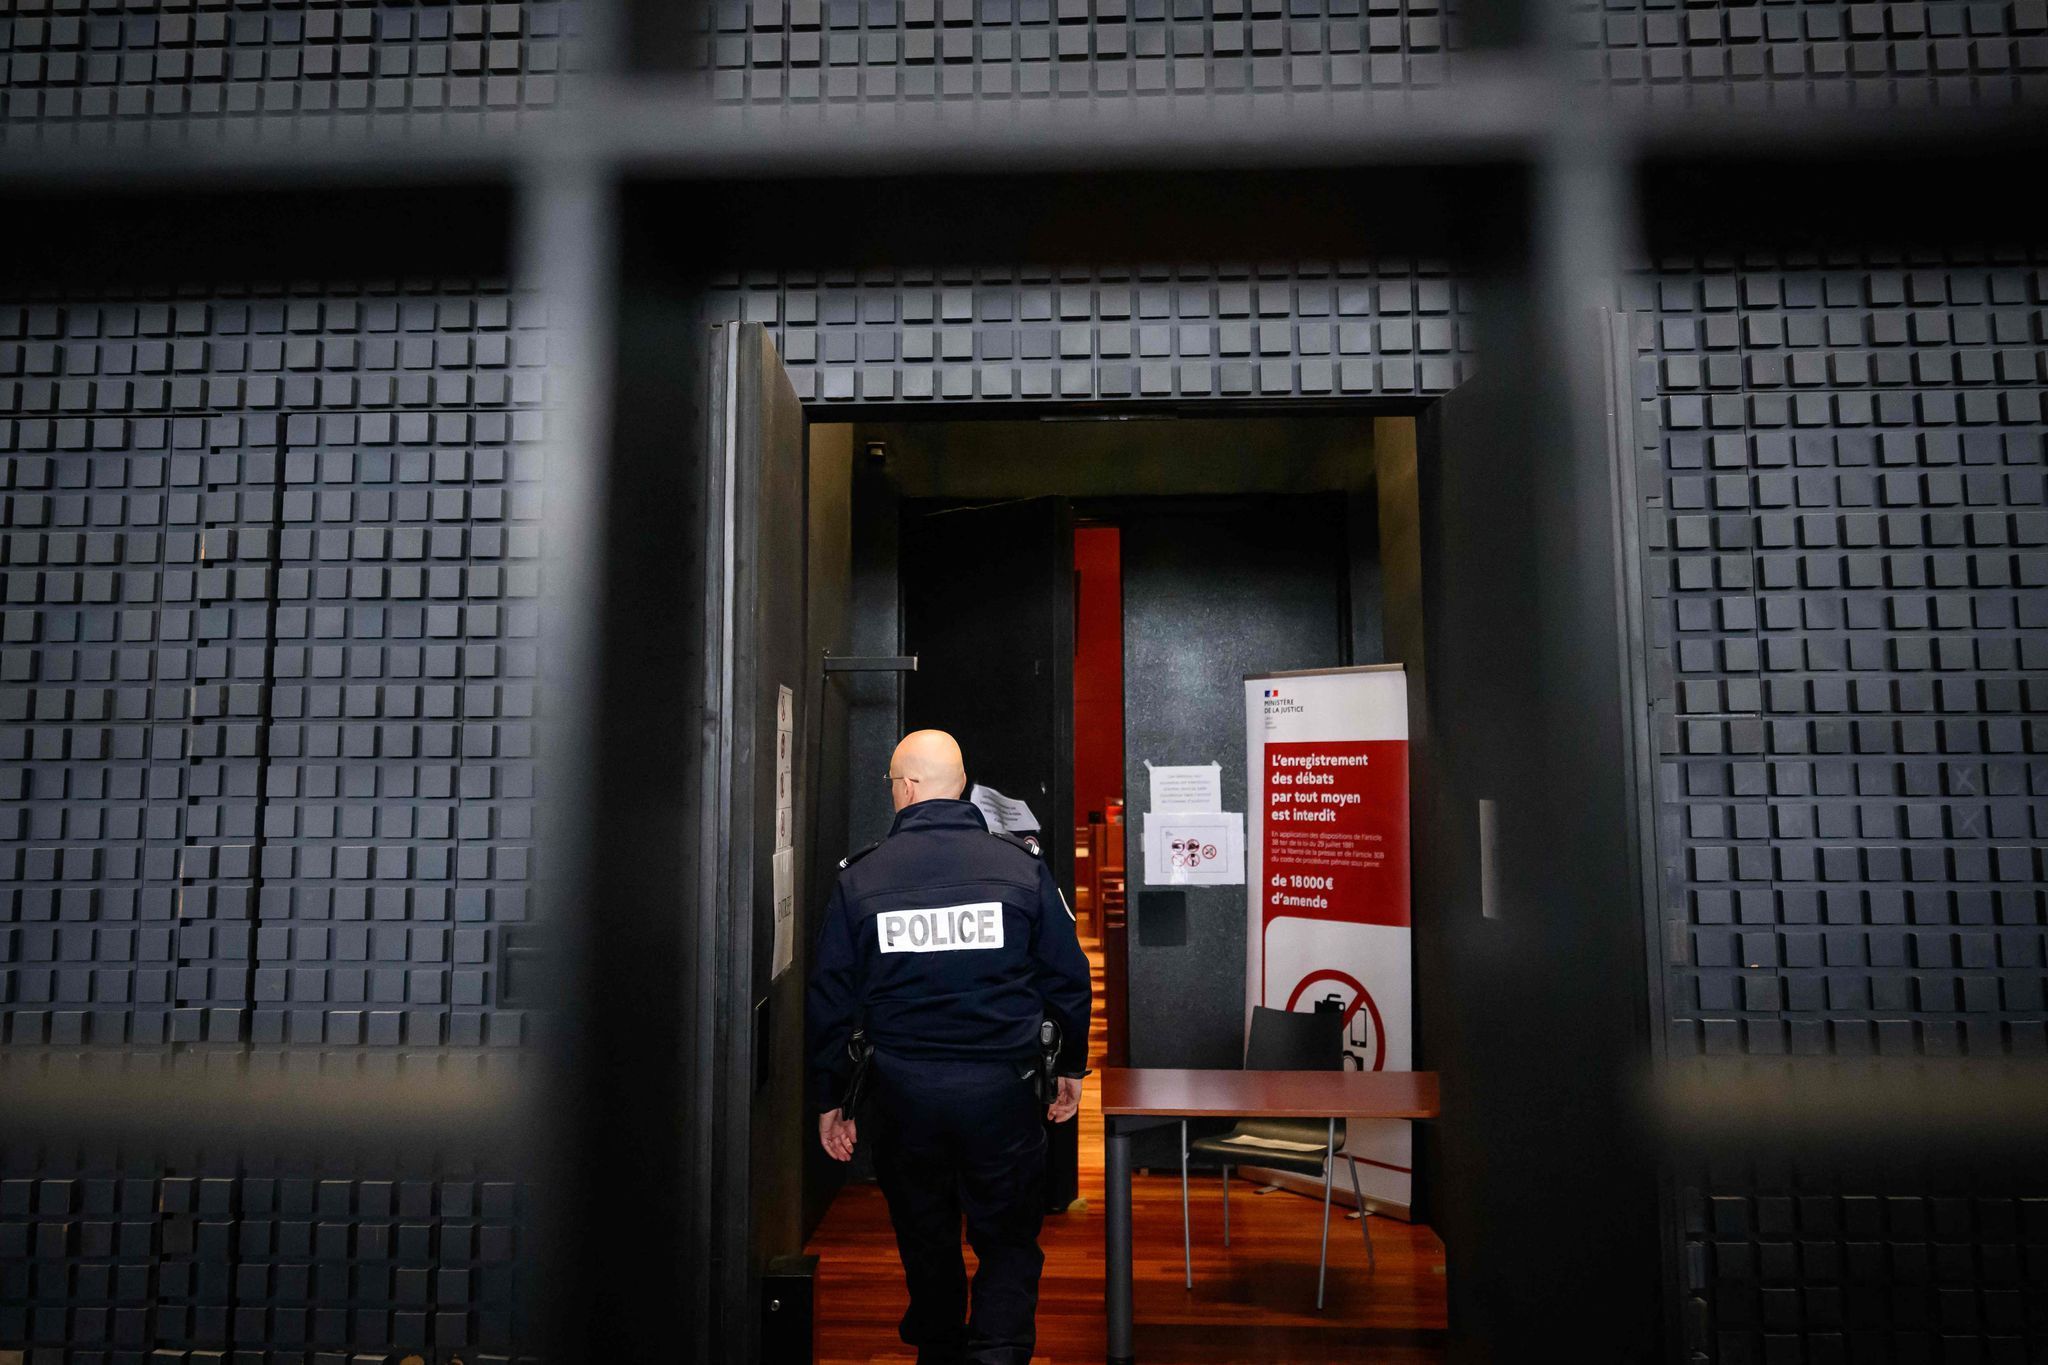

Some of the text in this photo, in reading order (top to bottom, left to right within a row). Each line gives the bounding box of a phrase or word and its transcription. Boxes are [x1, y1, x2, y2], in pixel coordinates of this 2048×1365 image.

[1264, 698, 1294, 706] MINISTÈRE
[1280, 705, 1304, 714] JUSTICE
[1272, 753, 1368, 770] L'enregistrement
[1271, 771, 1334, 785] des débats
[1271, 791, 1361, 807] par tout moyen
[1271, 808, 1336, 822] est interdit
[1279, 831, 1309, 839] application
[1319, 832, 1353, 840] dispositions
[1324, 841, 1341, 849] juillet
[1271, 855, 1280, 863] du
[1271, 873, 1287, 887] de
[1271, 891, 1328, 909] d'amende
[885, 909, 996, 948] POLICE
